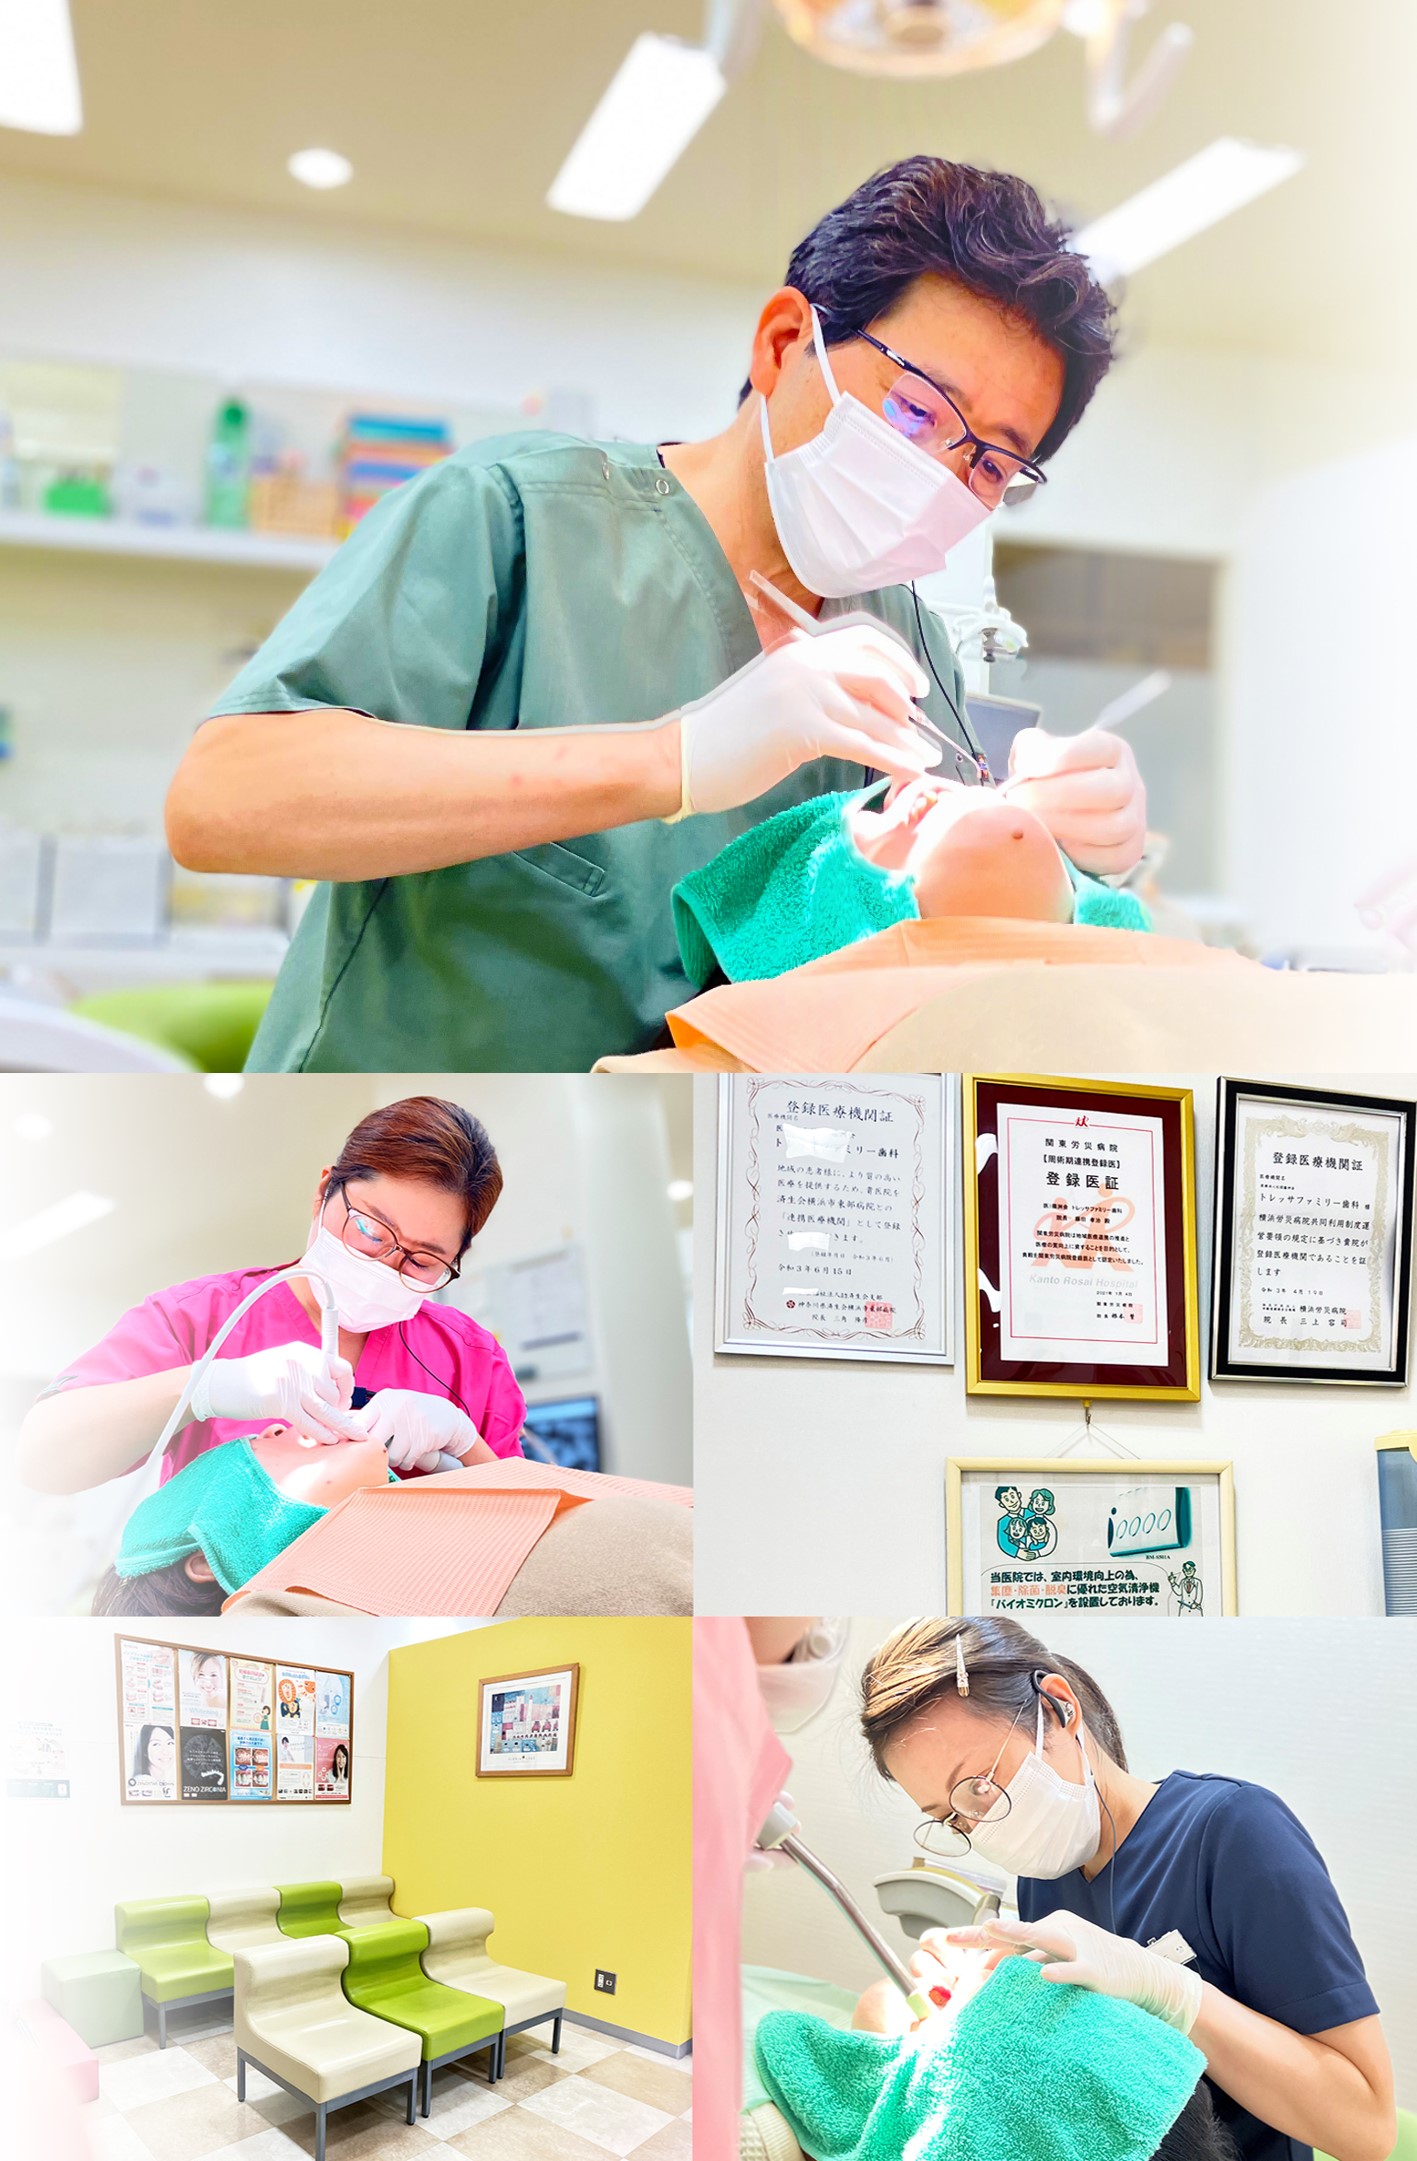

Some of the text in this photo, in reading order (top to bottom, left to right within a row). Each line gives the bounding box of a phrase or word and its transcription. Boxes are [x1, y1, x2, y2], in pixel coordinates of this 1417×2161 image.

[786, 1100, 894, 1123] 登録医療機関証
[1045, 1138, 1118, 1153] 関東労災病院
[1272, 1152, 1364, 1171] 登録医療機関証
[1046, 1171, 1120, 1191] 登録医証
[1260, 1192, 1360, 1210] トレッサファミリー歯科
[1258, 1213, 1371, 1231] 横浜労災病院共同利用制度運
[1257, 1231, 1369, 1248] 営要領の規定に基づき貴院が
[1256, 1250, 1367, 1265] 登録医療機関であることを証
[1257, 1267, 1281, 1277] します
[1029, 1274, 1139, 1291] Kanto Rosai Hospital
[990, 1569, 1139, 1584] 当医院では、室内環境向上の為、
[990, 1596, 1160, 1610] 「バイオミクロン」を設置しております。
